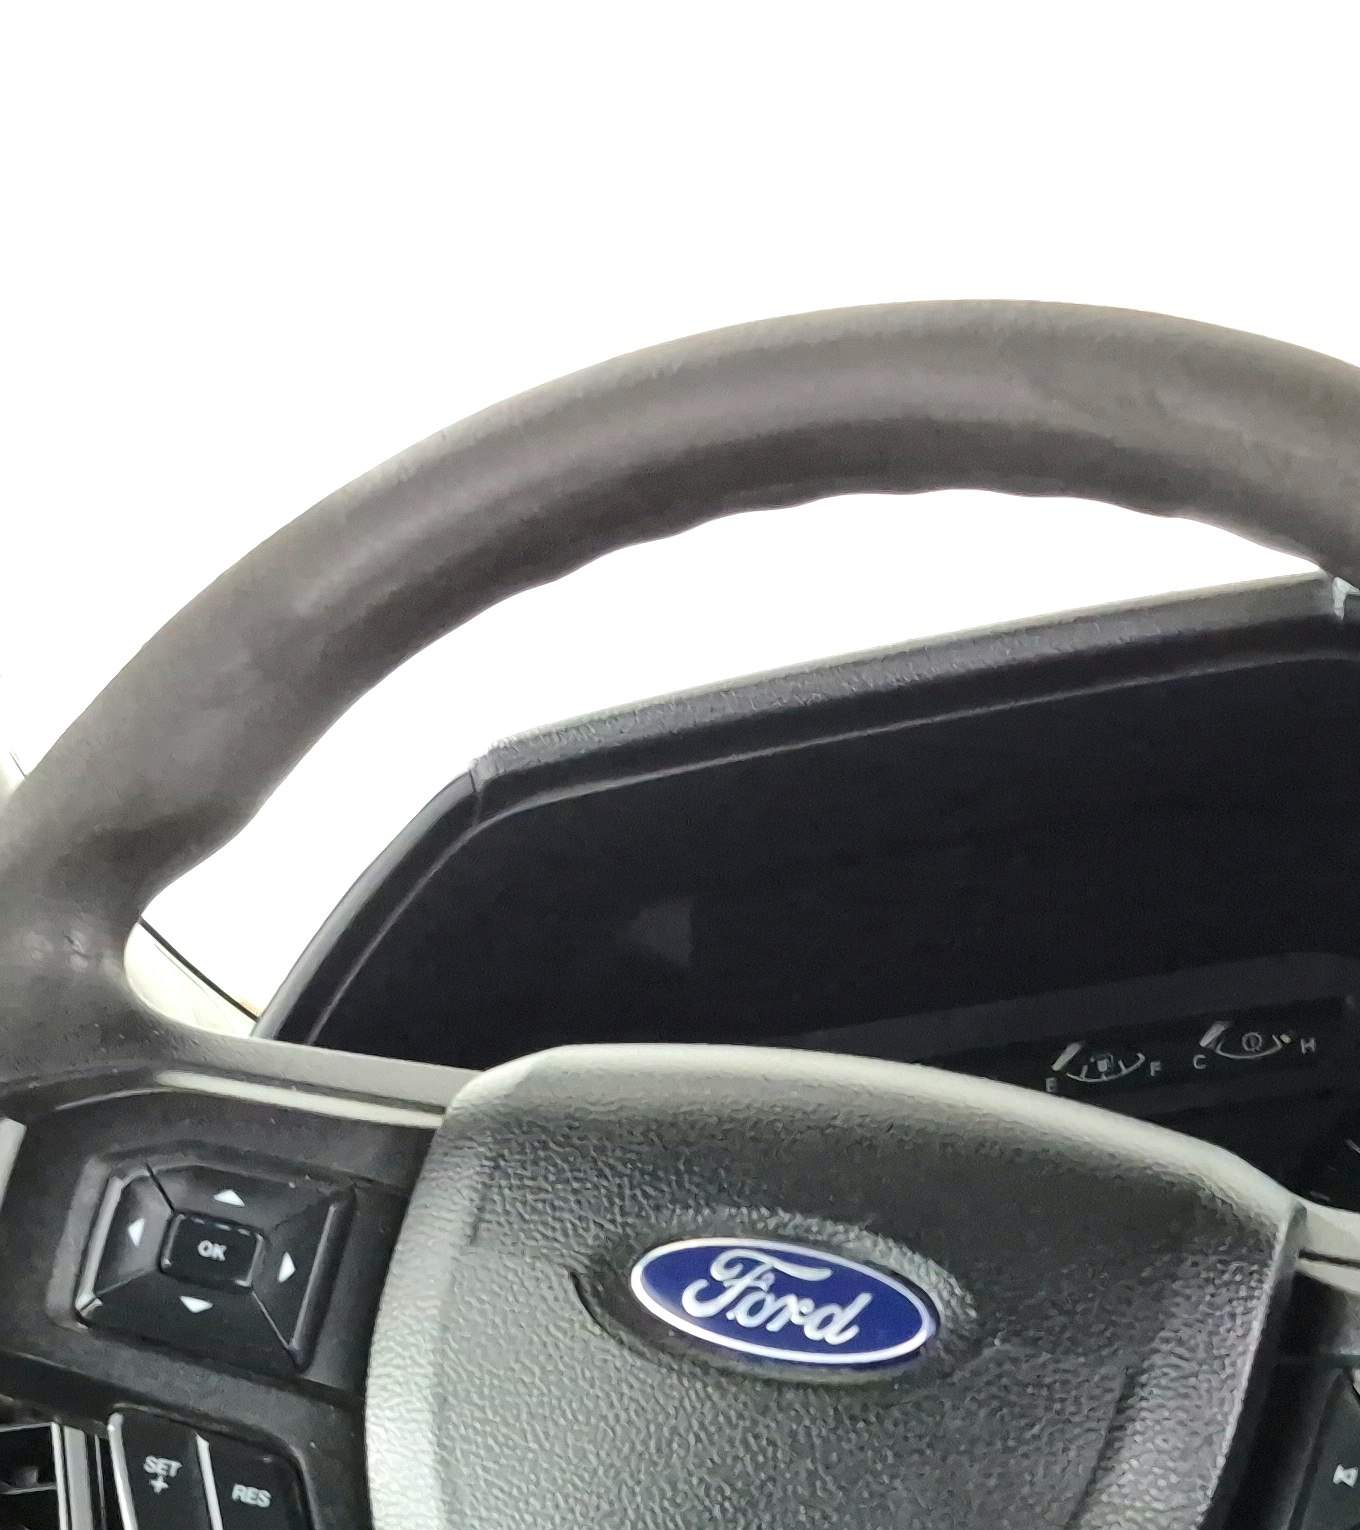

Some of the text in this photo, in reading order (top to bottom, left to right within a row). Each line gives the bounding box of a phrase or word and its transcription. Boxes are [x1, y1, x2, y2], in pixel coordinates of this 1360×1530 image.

[1299, 1037, 1317, 1055] H
[1149, 1060, 1163, 1077] F
[1191, 1053, 1207, 1070] C
[196, 1239, 227, 1262] OK
[681, 1249, 874, 1346] Ford
[143, 1455, 183, 1478] SET
[231, 1483, 272, 1509] RES
